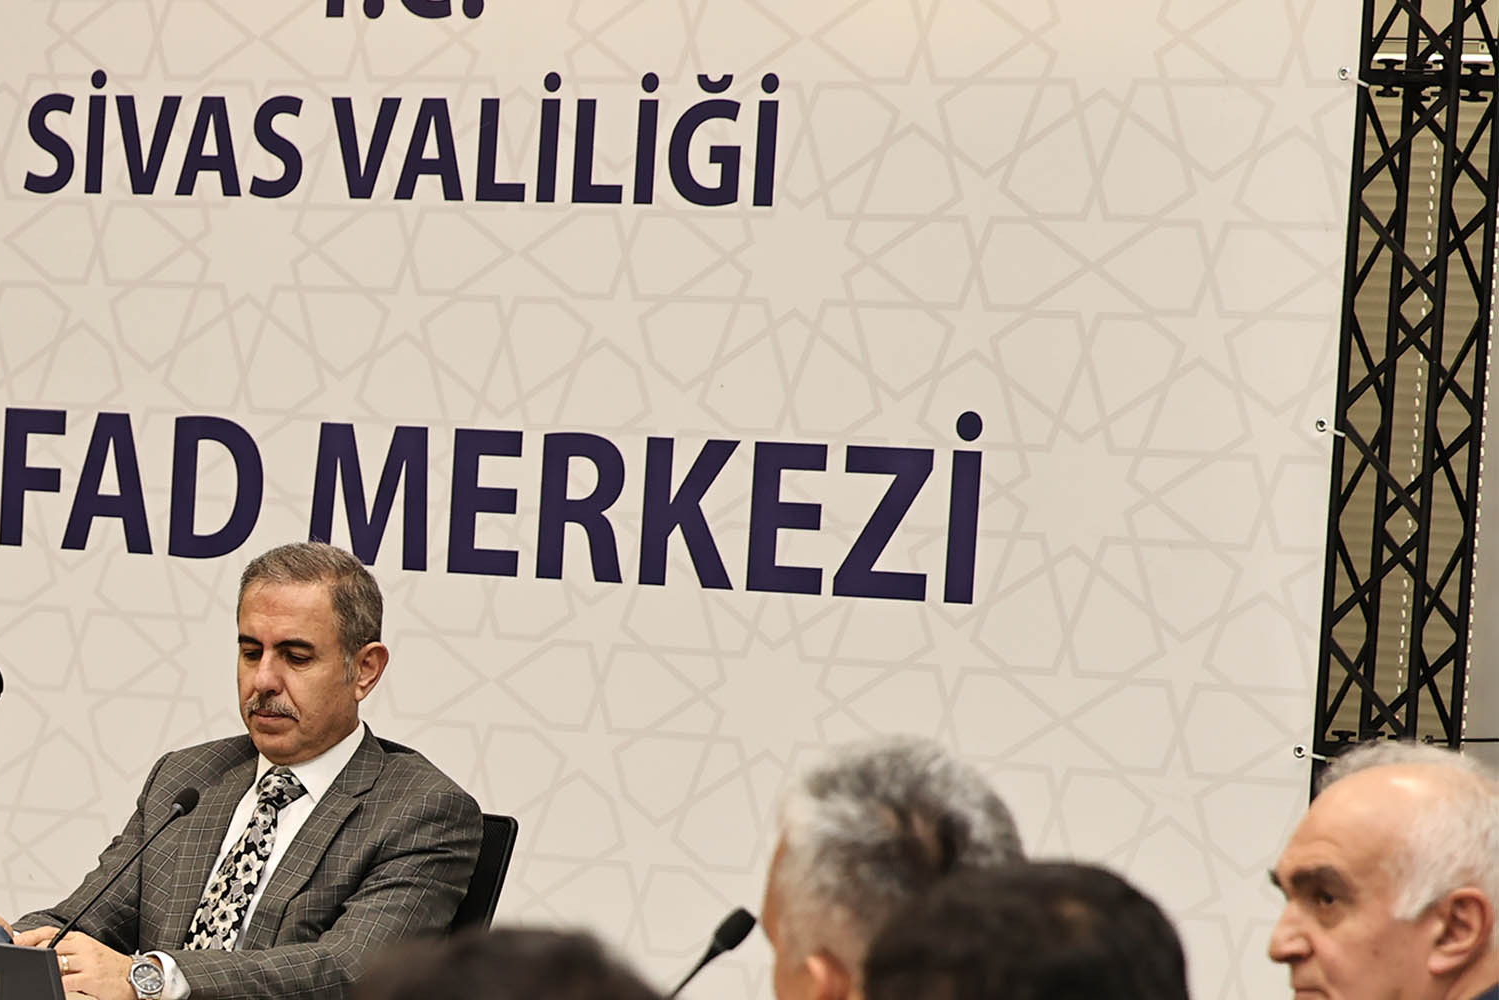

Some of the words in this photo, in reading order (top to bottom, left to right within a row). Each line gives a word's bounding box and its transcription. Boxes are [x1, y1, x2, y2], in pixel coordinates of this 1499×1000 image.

[23, 69, 304, 199] SİVAS
[331, 71, 780, 207] VALİLİĞİ
[308, 410, 984, 605] MERKEZİ
